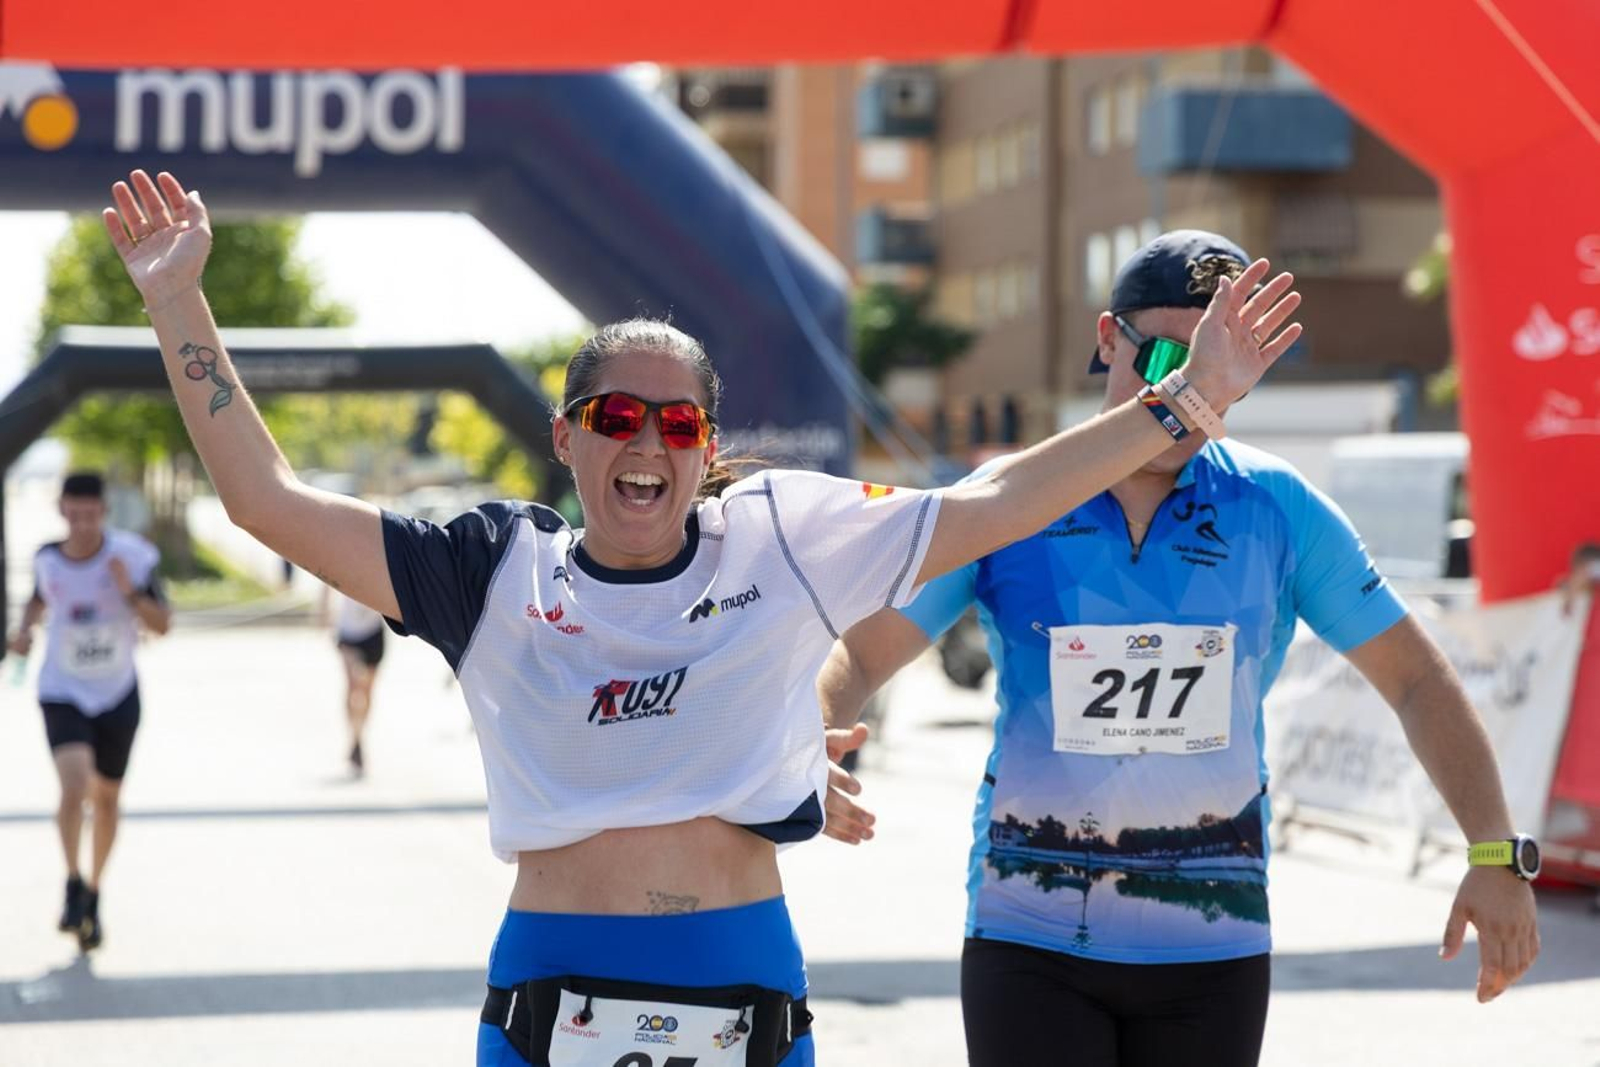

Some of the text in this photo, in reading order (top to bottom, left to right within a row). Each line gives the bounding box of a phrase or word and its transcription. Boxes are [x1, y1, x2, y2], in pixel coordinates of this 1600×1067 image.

[115, 67, 464, 178] mupol
[721, 584, 761, 612] mupol
[1082, 666, 1205, 719] 217
[1102, 727, 1185, 737] ELENA CANO JIMENEZ
[559, 1022, 600, 1039] Santander
[637, 1014, 678, 1033] 200
